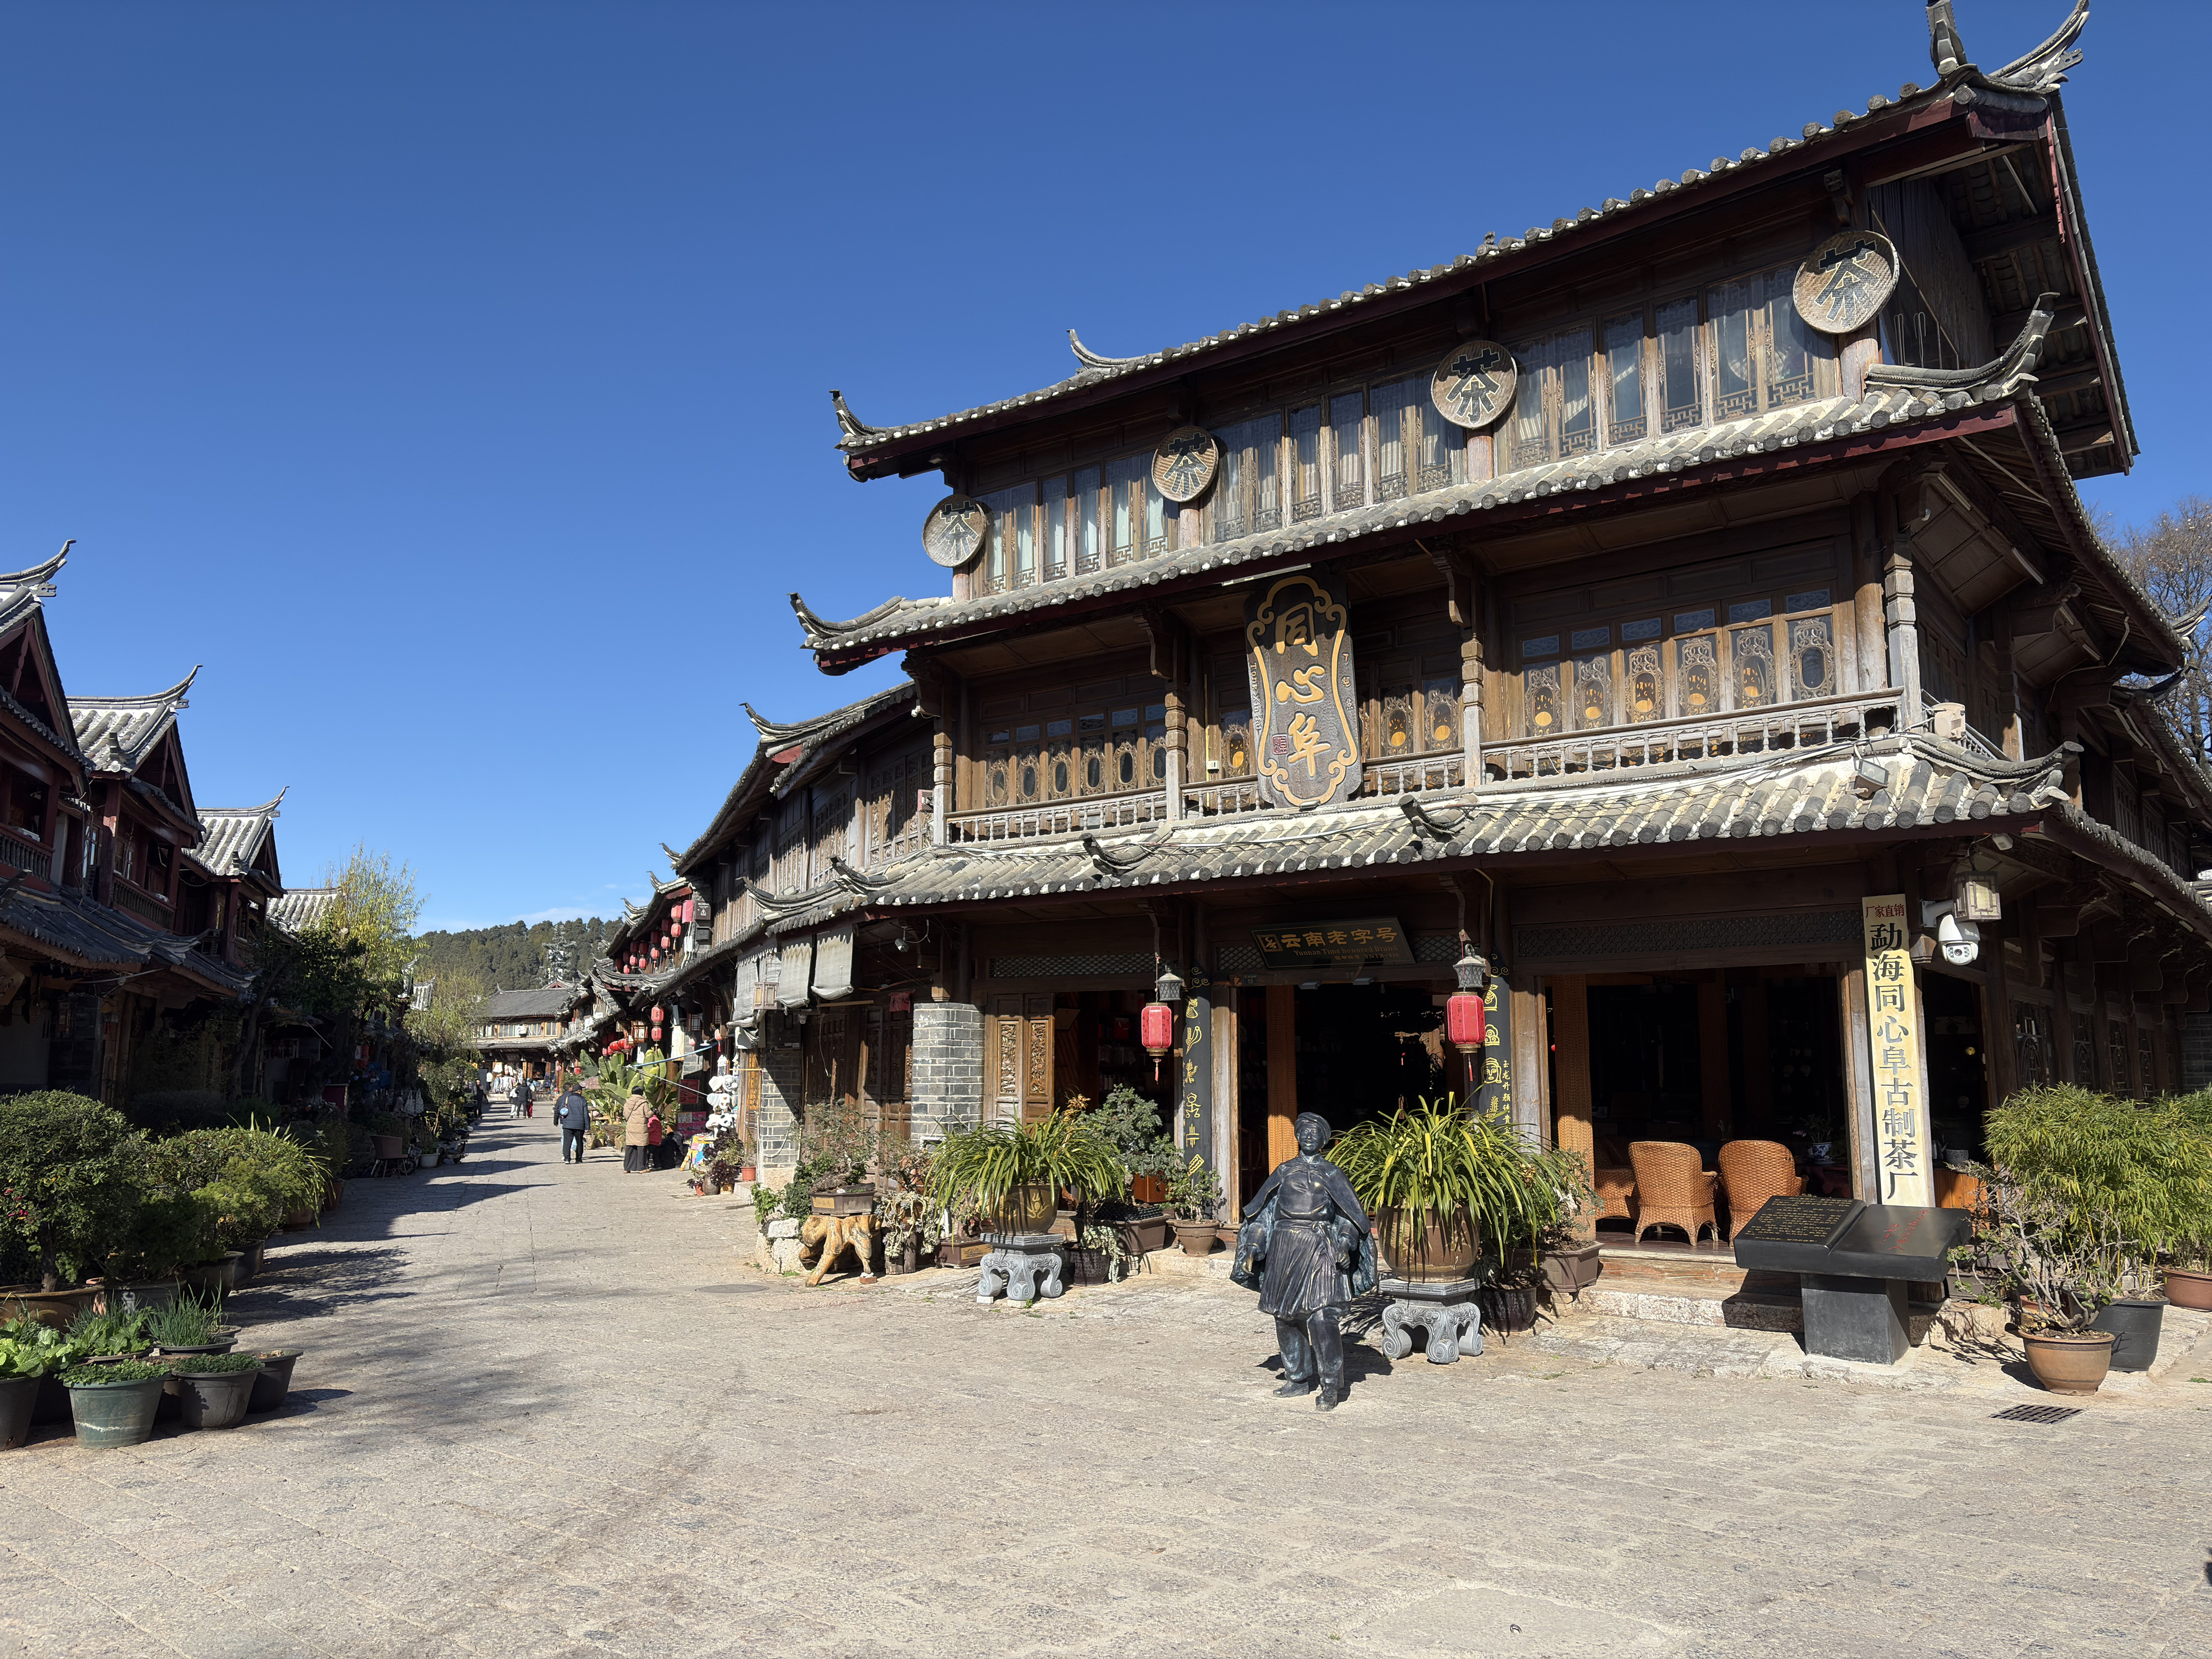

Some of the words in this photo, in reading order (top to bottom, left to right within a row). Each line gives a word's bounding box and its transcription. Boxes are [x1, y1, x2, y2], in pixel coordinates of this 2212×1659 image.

[1250, 662, 1258, 690] Tong
[1275, 602, 1331, 778] 同心阜
[1865, 903, 1905, 919] 厂家直销
[1281, 927, 1398, 948] 云南老字号
[1870, 922, 1918, 1199] 勐海同心阜古制茶厂
